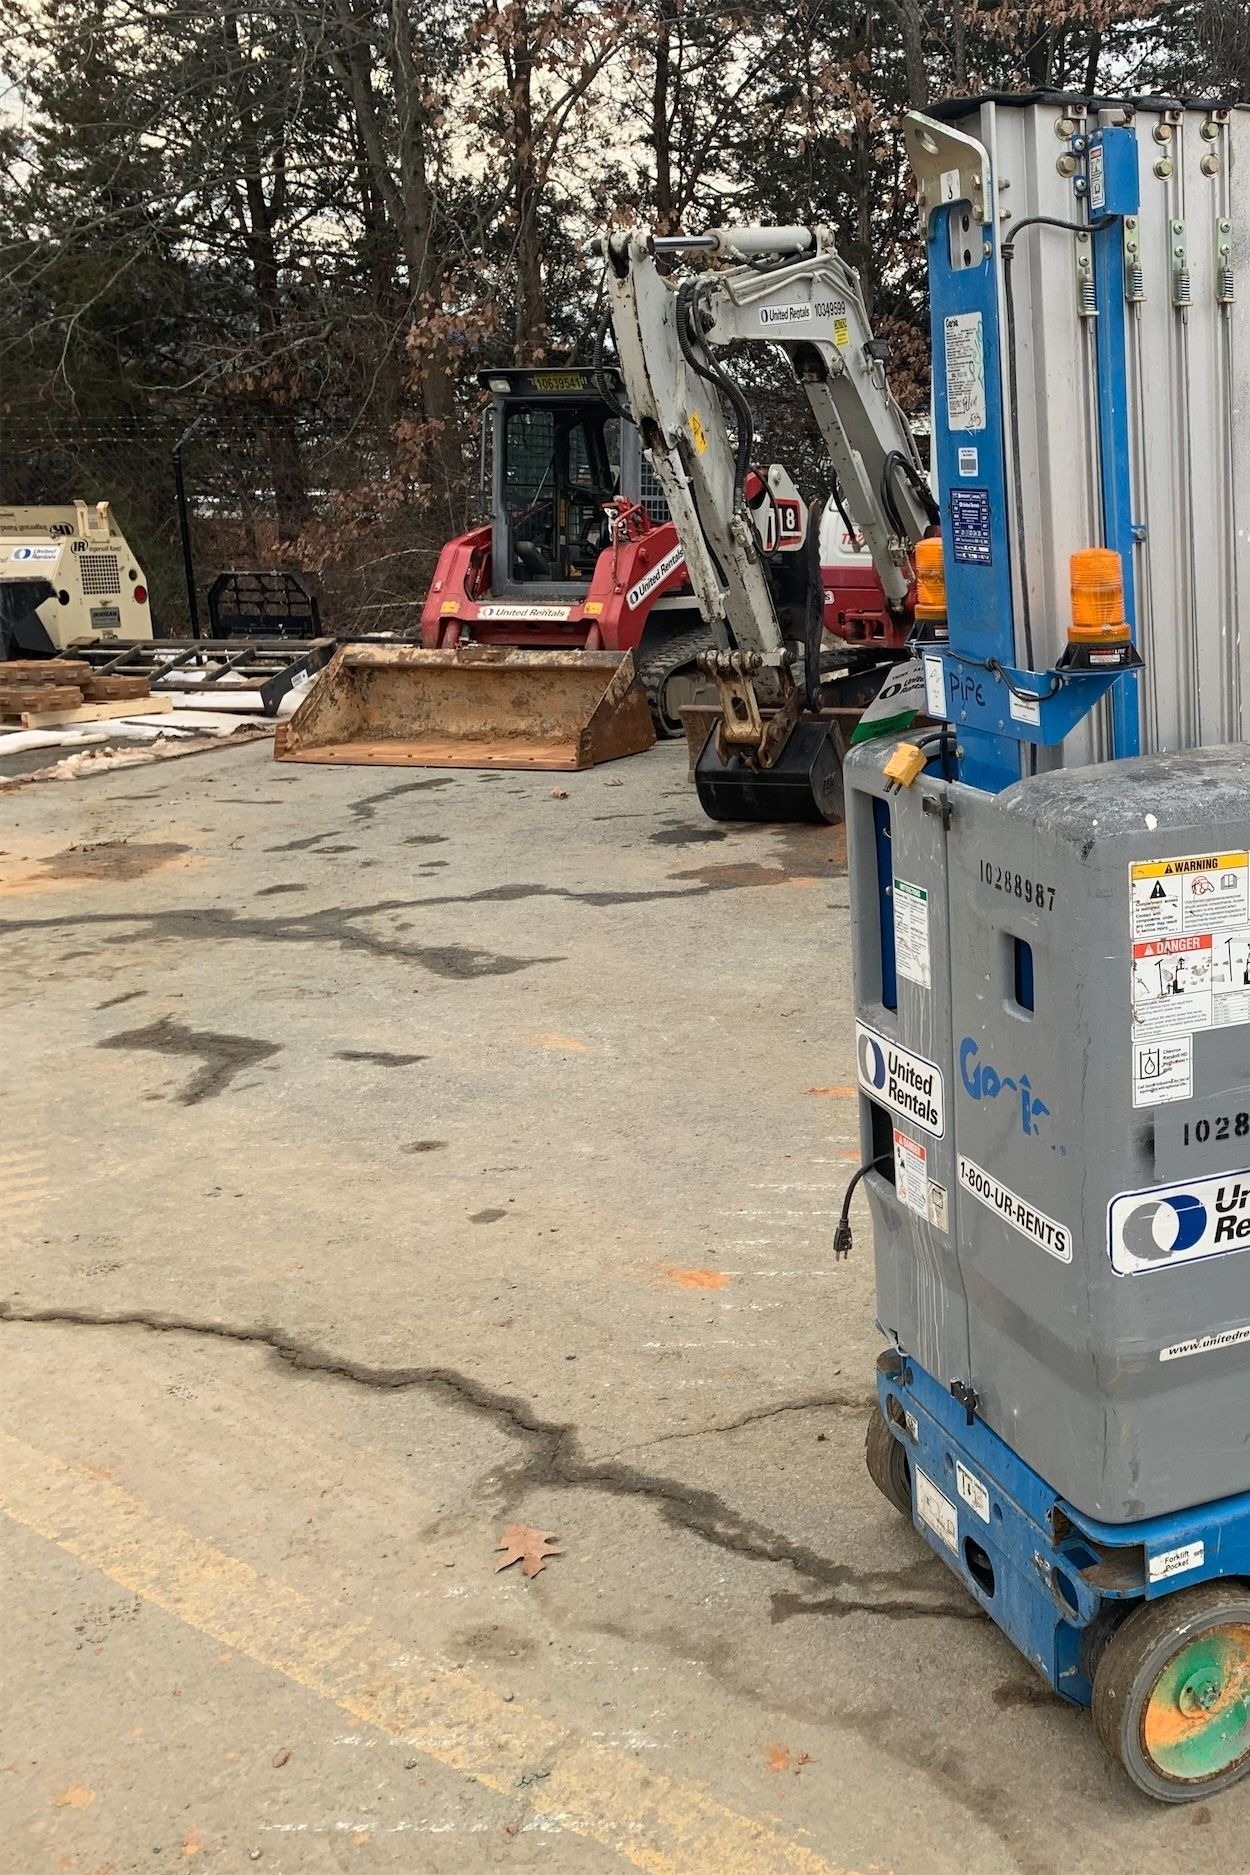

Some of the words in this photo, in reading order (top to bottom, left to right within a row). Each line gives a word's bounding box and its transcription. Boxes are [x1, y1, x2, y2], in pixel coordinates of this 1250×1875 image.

[769, 308, 789, 321] United
[789, 306, 810, 320] Rentals
[536, 377, 581, 389] 10639541
[73, 541, 86, 552] IR
[638, 572, 662, 597] United
[659, 548, 684, 577] Rentals
[495, 608, 529, 617] United
[529, 607, 566, 618] Rentals
[1174, 858, 1219, 873] WARNING
[979, 858, 1056, 912] 10288987
[1156, 937, 1201, 955] DANGER
[888, 1050, 933, 1098] United
[888, 1077, 939, 1127] Rentals
[960, 1160, 1066, 1252] 1-800-UR-RENTS
[1164, 1550, 1189, 1565] Forklift
[1165, 1559, 1189, 1571] Pocket
